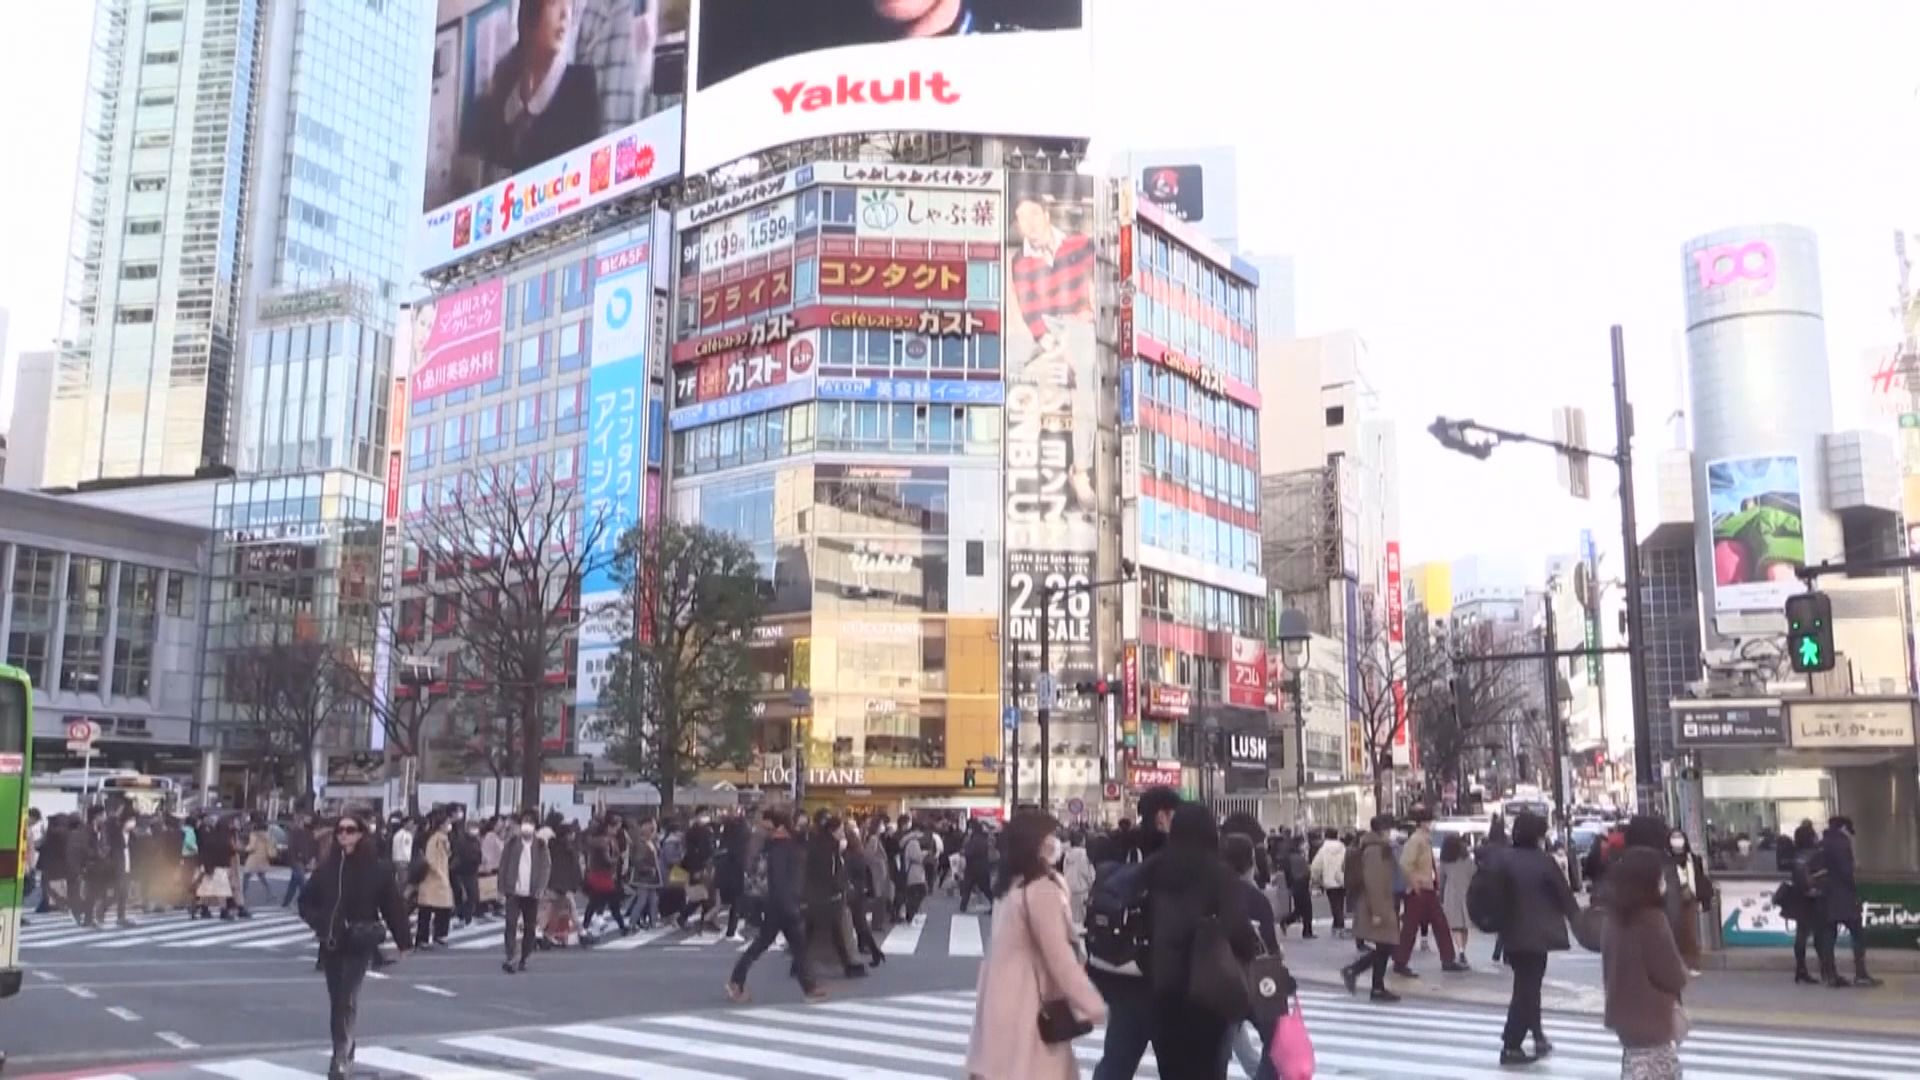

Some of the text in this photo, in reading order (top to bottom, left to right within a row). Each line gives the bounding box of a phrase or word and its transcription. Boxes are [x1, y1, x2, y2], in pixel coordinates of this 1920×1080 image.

[772, 71, 962, 114] Yakult
[842, 164, 993, 187] しゃぶしゃぶバイキング
[906, 198, 996, 226] しゃぶ葉
[683, 244, 700, 262] 9F
[821, 262, 960, 290] コンタクト
[1693, 240, 1777, 296] 109
[702, 272, 790, 320] プライス
[749, 314, 796, 346] ガスト
[917, 311, 985, 336] ガスト
[726, 353, 783, 394] ガスト
[678, 376, 696, 399] 7F
[876, 381, 1000, 399] 英会話イーオン
[1009, 571, 1090, 619] 2.26
[1009, 618, 1091, 642] ON SALE
[1235, 664, 1259, 687] アコム
[1231, 735, 1266, 760] LUSH
